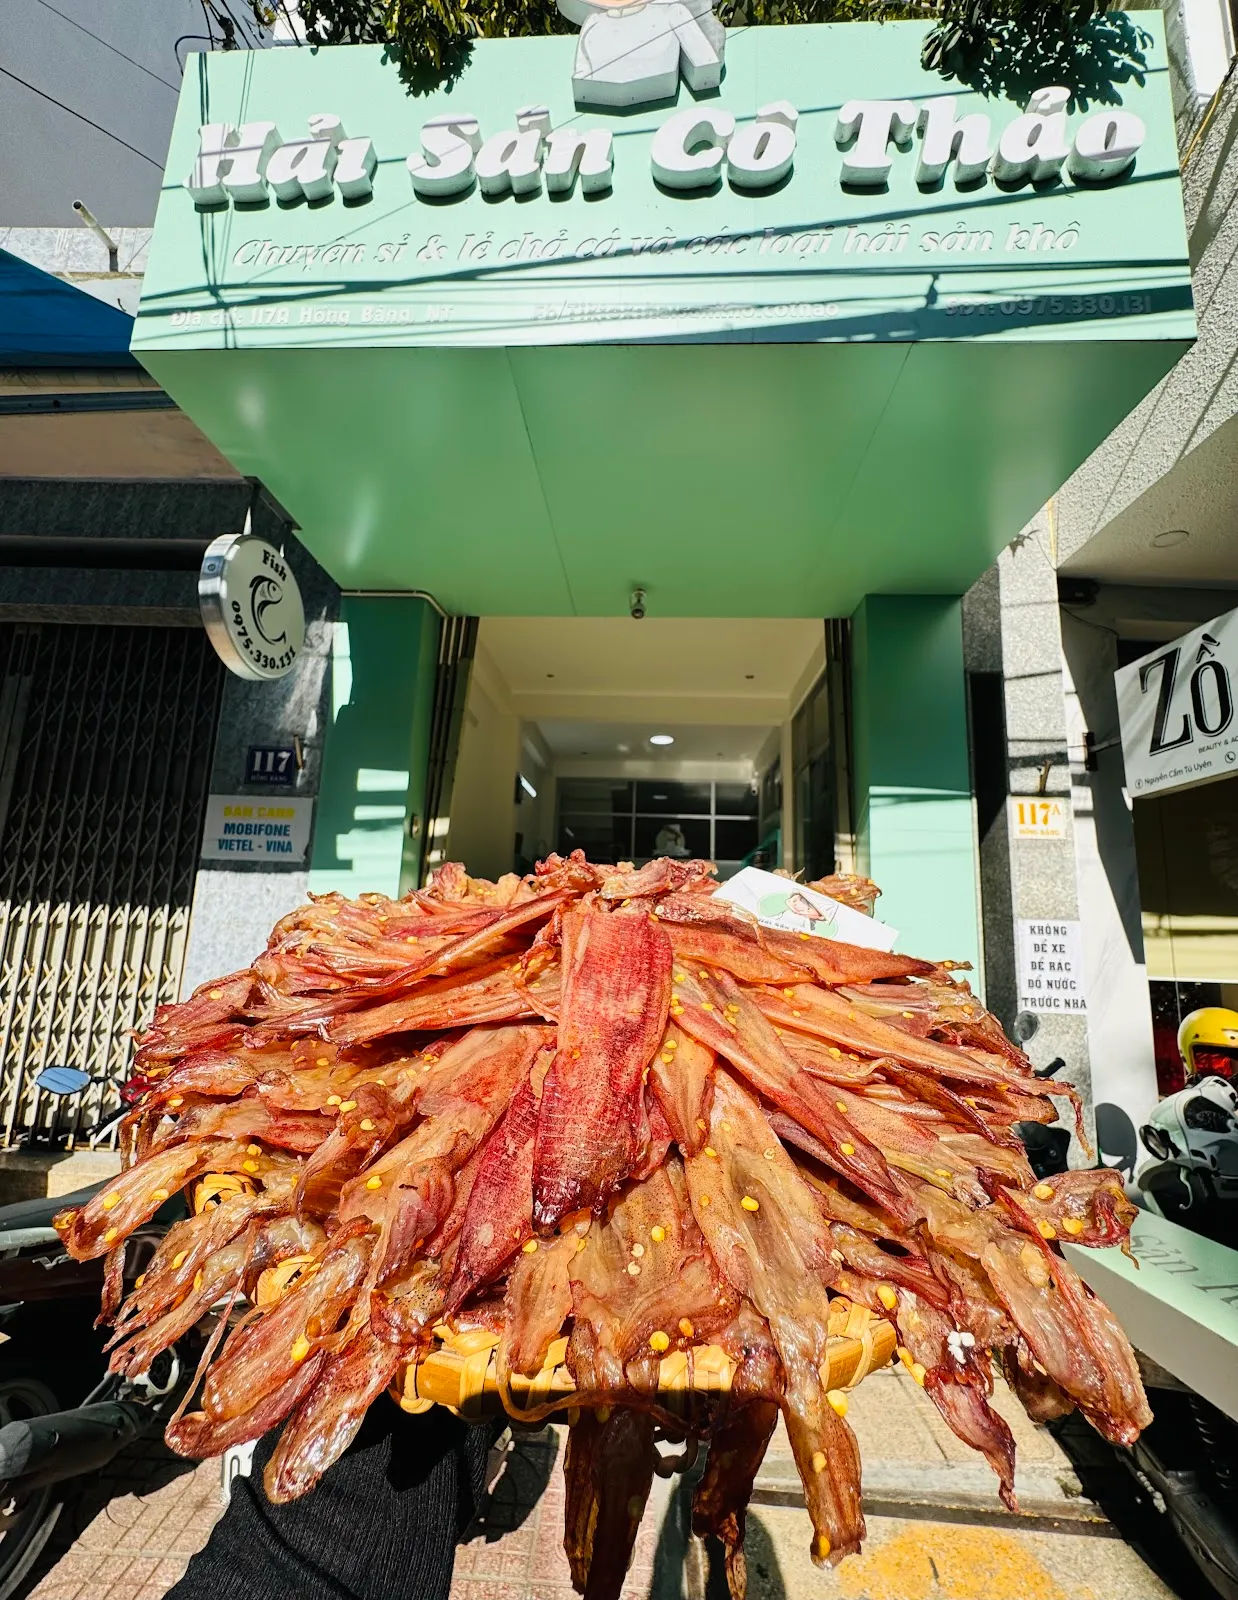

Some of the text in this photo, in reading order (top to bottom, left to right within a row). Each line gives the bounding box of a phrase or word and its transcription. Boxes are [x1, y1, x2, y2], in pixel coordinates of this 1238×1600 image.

[183, 86, 1146, 201] Hải Sản Cô Thảo
[232, 220, 1081, 272] Chuyên sỉ & lẻ chả cá và các loại hải sản khô
[1000, 295, 1150, 316] 0975.330.131
[263, 549, 287, 582] Fish
[231, 600, 296, 669] 0975.330.131
[253, 751, 292, 773] 117
[223, 822, 291, 837] MOBIFONE
[217, 838, 254, 852] VIETEL
[266, 840, 293, 853] VINA
[1051, 943, 1066, 953] XE
